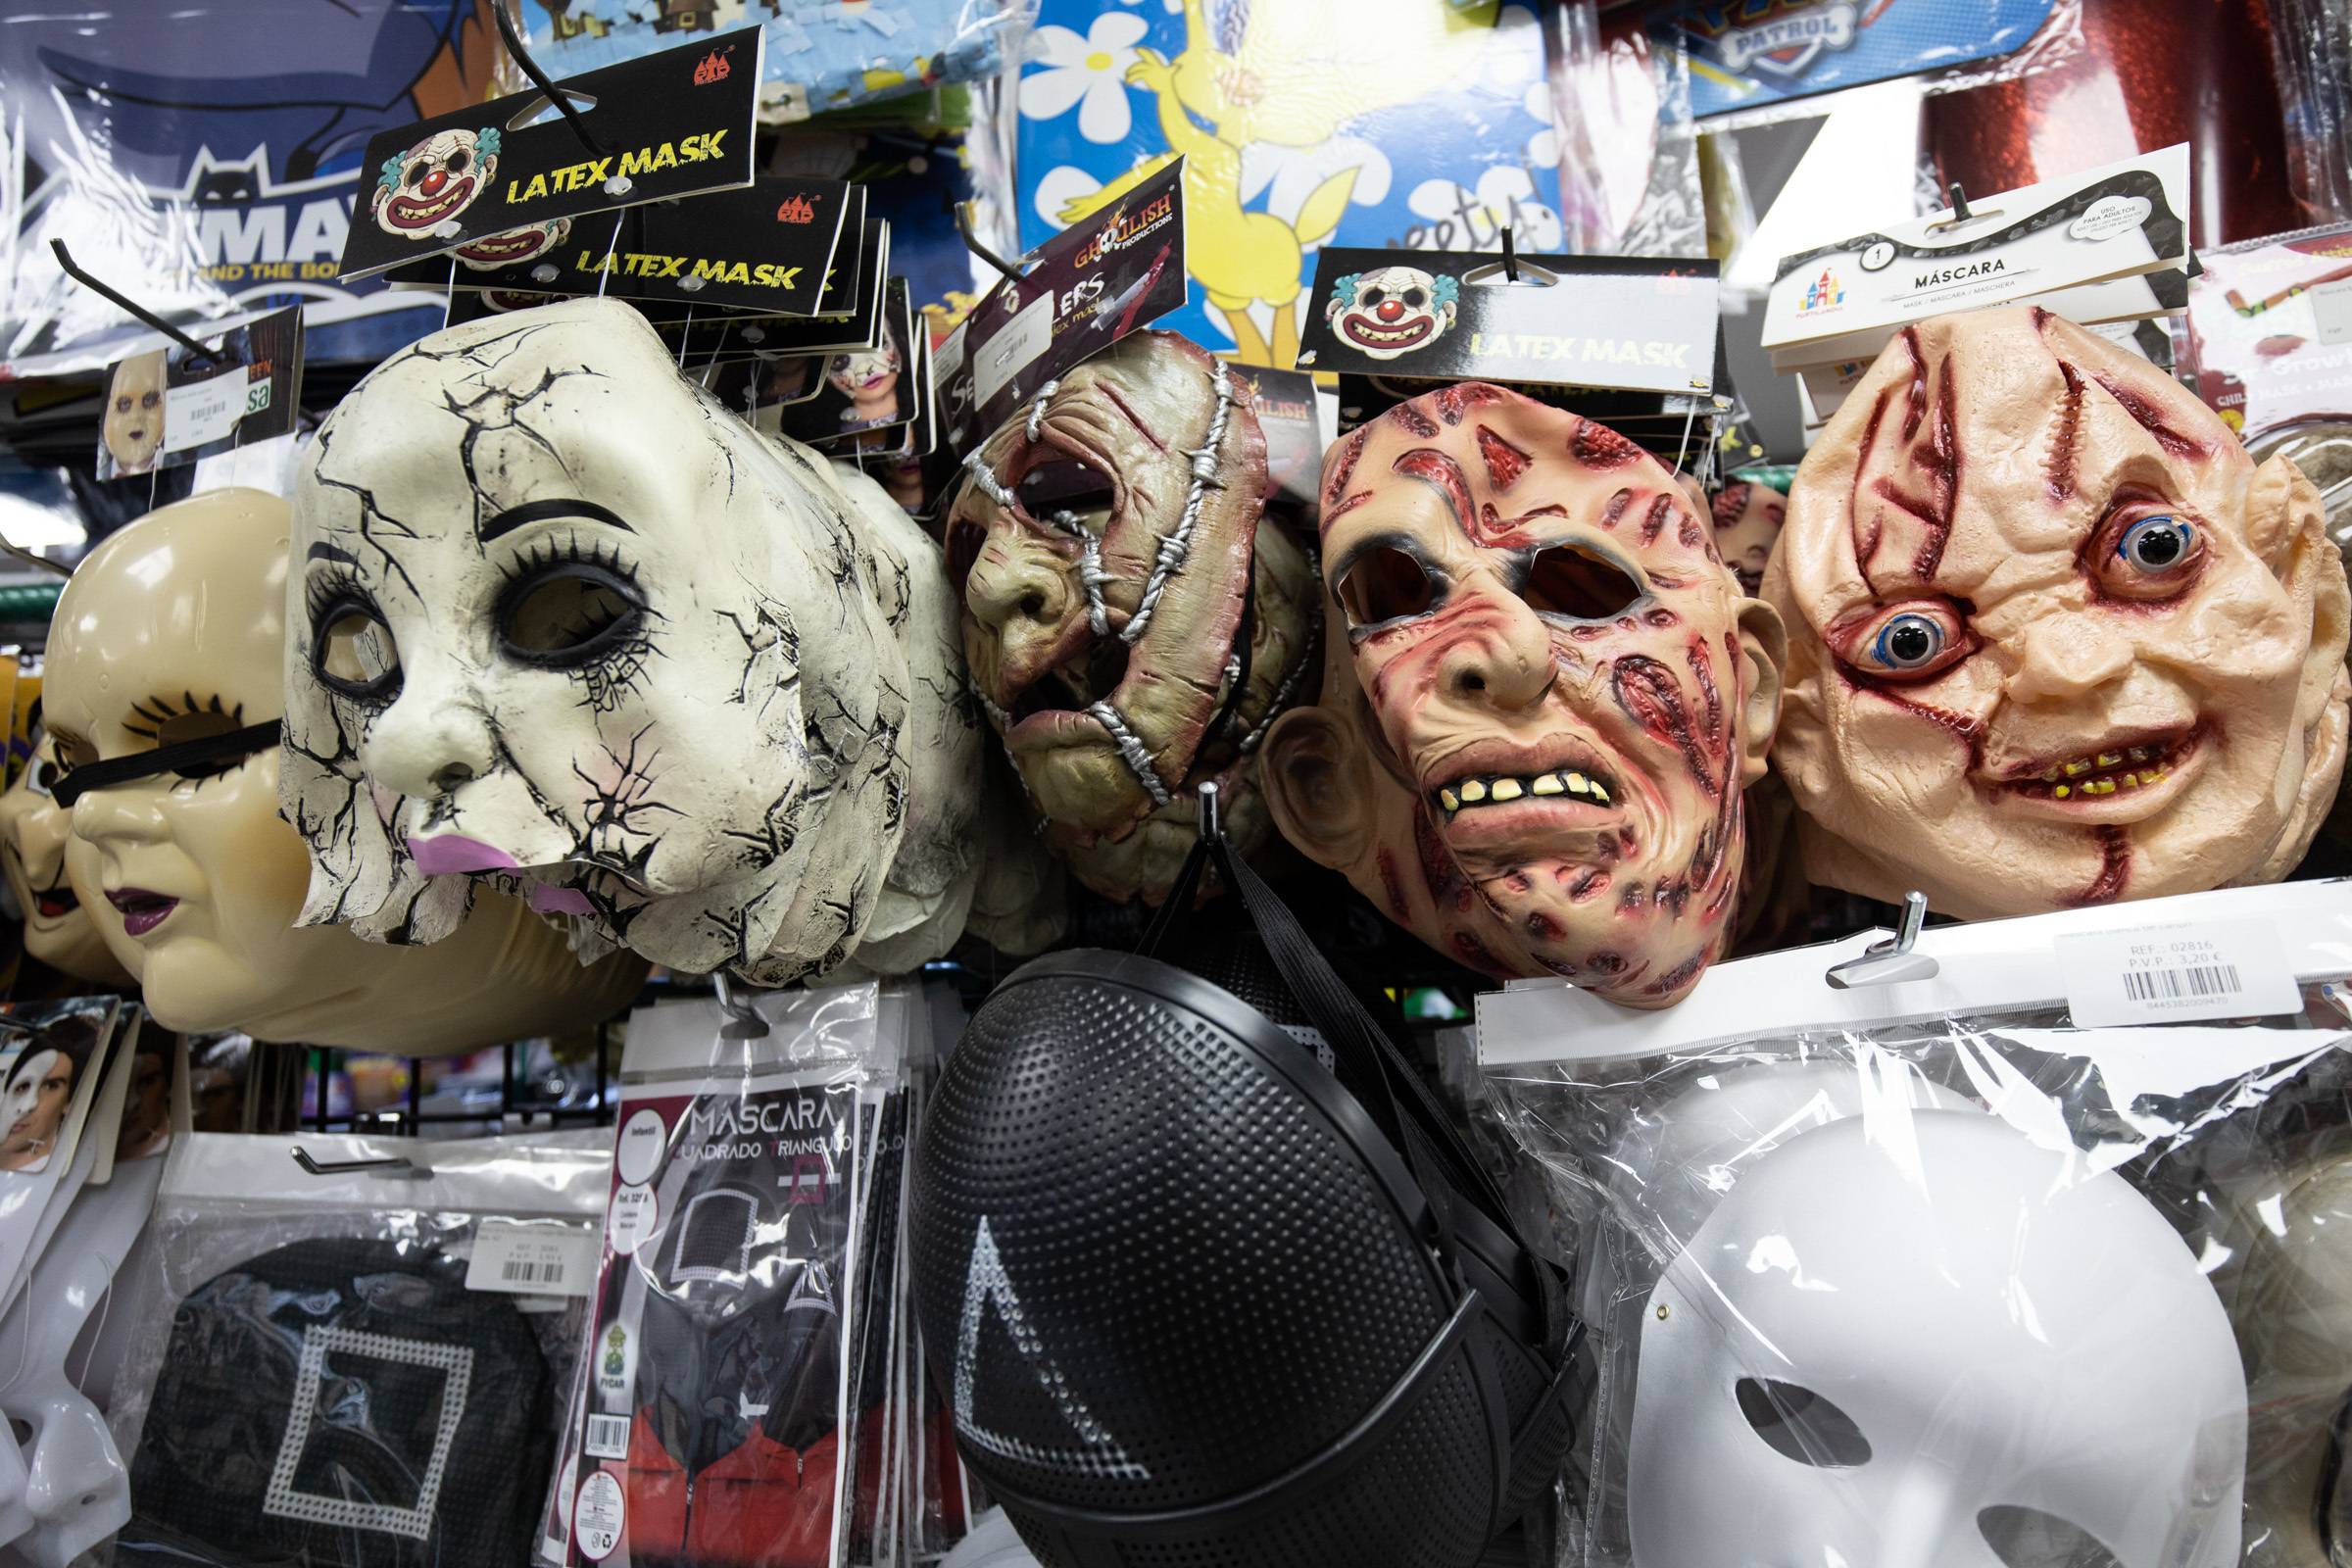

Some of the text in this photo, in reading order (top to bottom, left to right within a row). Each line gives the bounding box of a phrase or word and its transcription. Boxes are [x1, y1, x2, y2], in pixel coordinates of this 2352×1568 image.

[1735, 17, 1838, 52] PATROL
[506, 128, 729, 204] LATEX MASK
[1121, 212, 1173, 251] PRODUCTIONS
[250, 262, 294, 279] THE
[300, 261, 339, 278] BO
[575, 250, 689, 278] LATEX
[688, 258, 804, 291] MASK
[1914, 258, 2006, 290] MÁSCARA
[1470, 333, 1691, 369] LATEX MASK
[2171, 940, 2214, 953] 02816
[771, 1134, 854, 1158] TRIANGUO
